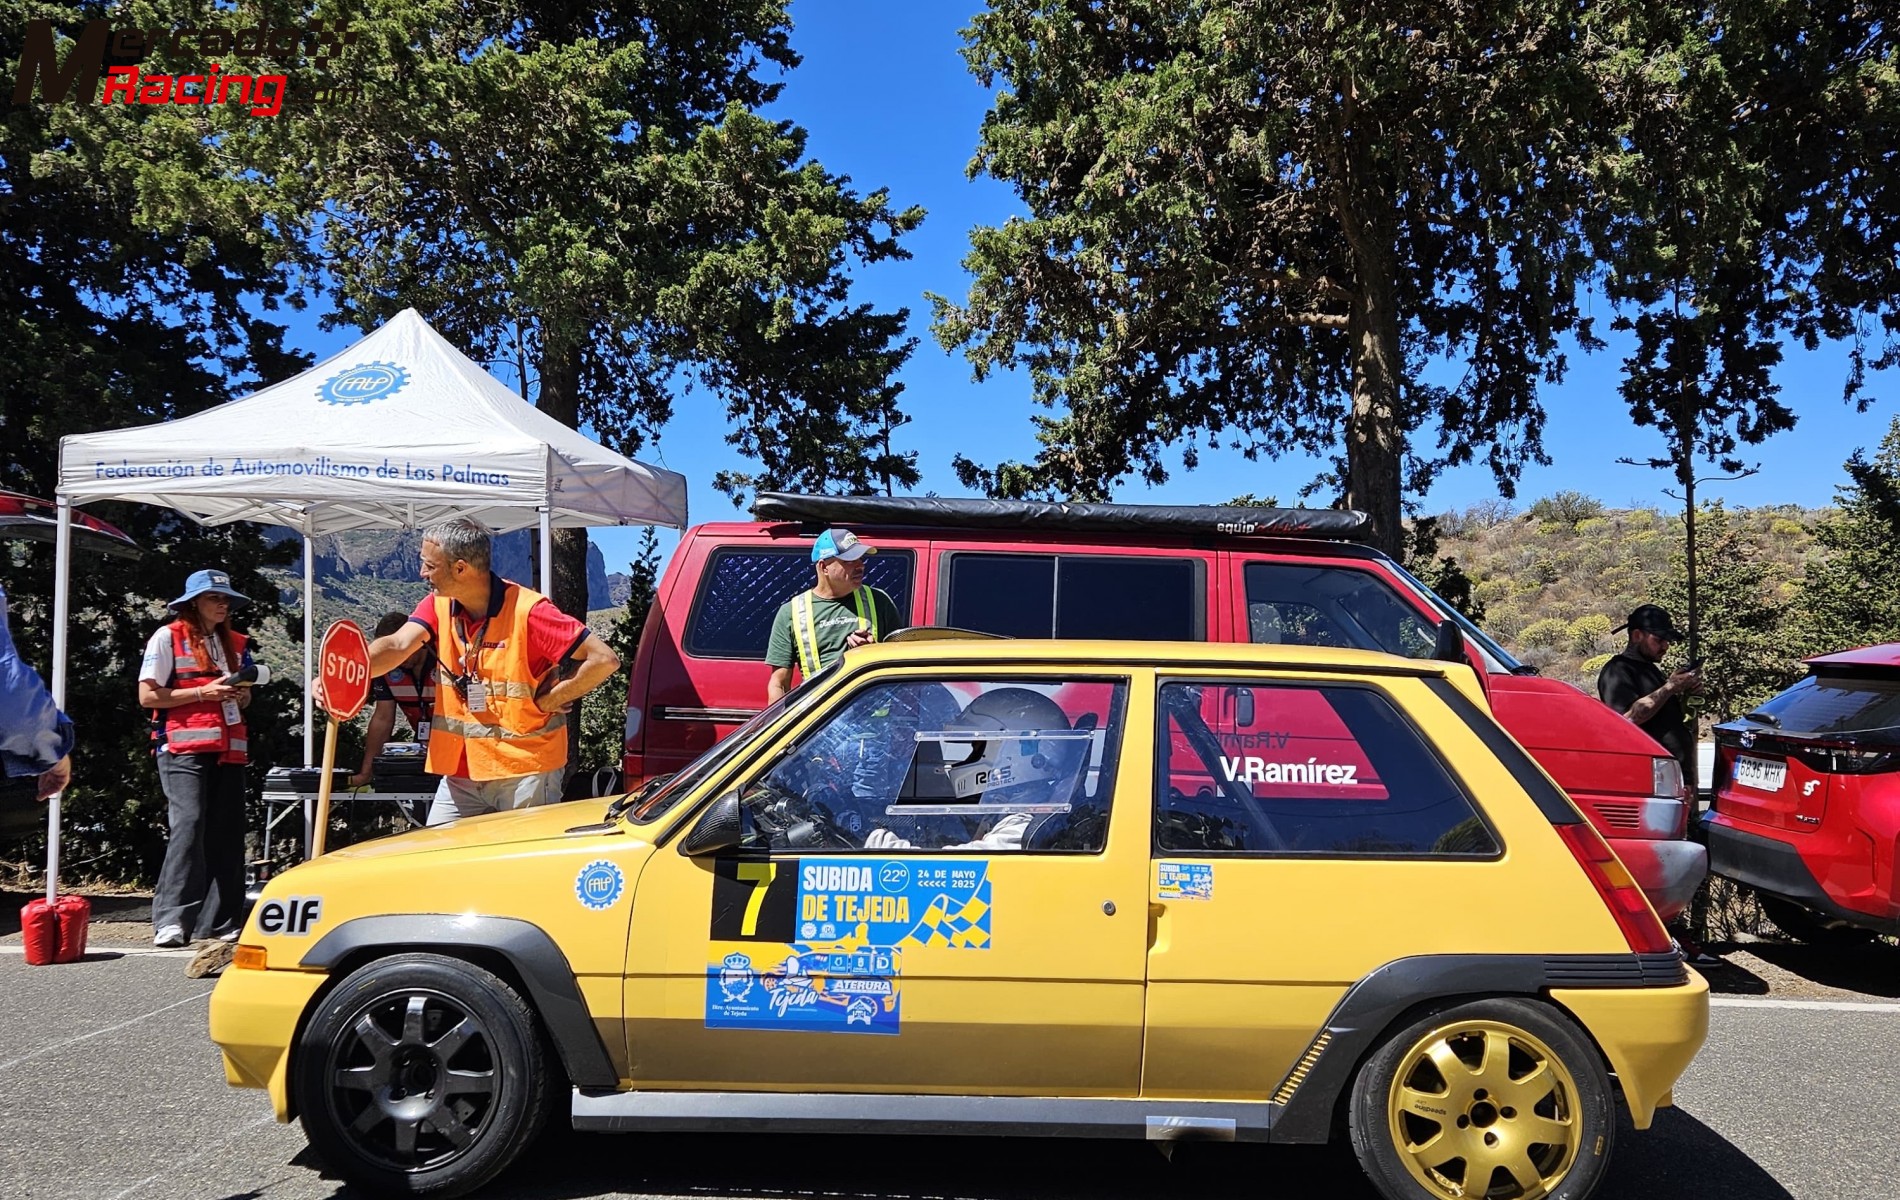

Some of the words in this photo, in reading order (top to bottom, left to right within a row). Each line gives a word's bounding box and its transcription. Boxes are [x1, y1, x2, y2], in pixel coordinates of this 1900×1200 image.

[96, 459, 195, 479] Federación
[201, 457, 224, 476] de
[231, 457, 370, 477] Automovilismo
[376, 459, 399, 479] de
[406, 462, 435, 481] Las
[442, 464, 510, 486] Palmas
[327, 652, 366, 686] STOP
[1219, 756, 1358, 785] V.Ramírez
[1740, 759, 1763, 779] 6836
[1763, 762, 1784, 783] MHK
[803, 866, 873, 892] SUBIDA
[918, 870, 930, 878] 24
[935, 870, 947, 879] DE
[952, 870, 976, 879] MAYO
[952, 880, 975, 888] 2025
[737, 862, 777, 936] 7
[802, 894, 829, 922] DE
[834, 895, 910, 923] TEJEDA
[259, 899, 319, 933] elf
[834, 980, 891, 991] ATERURA
[768, 988, 819, 1018] Tejeda
